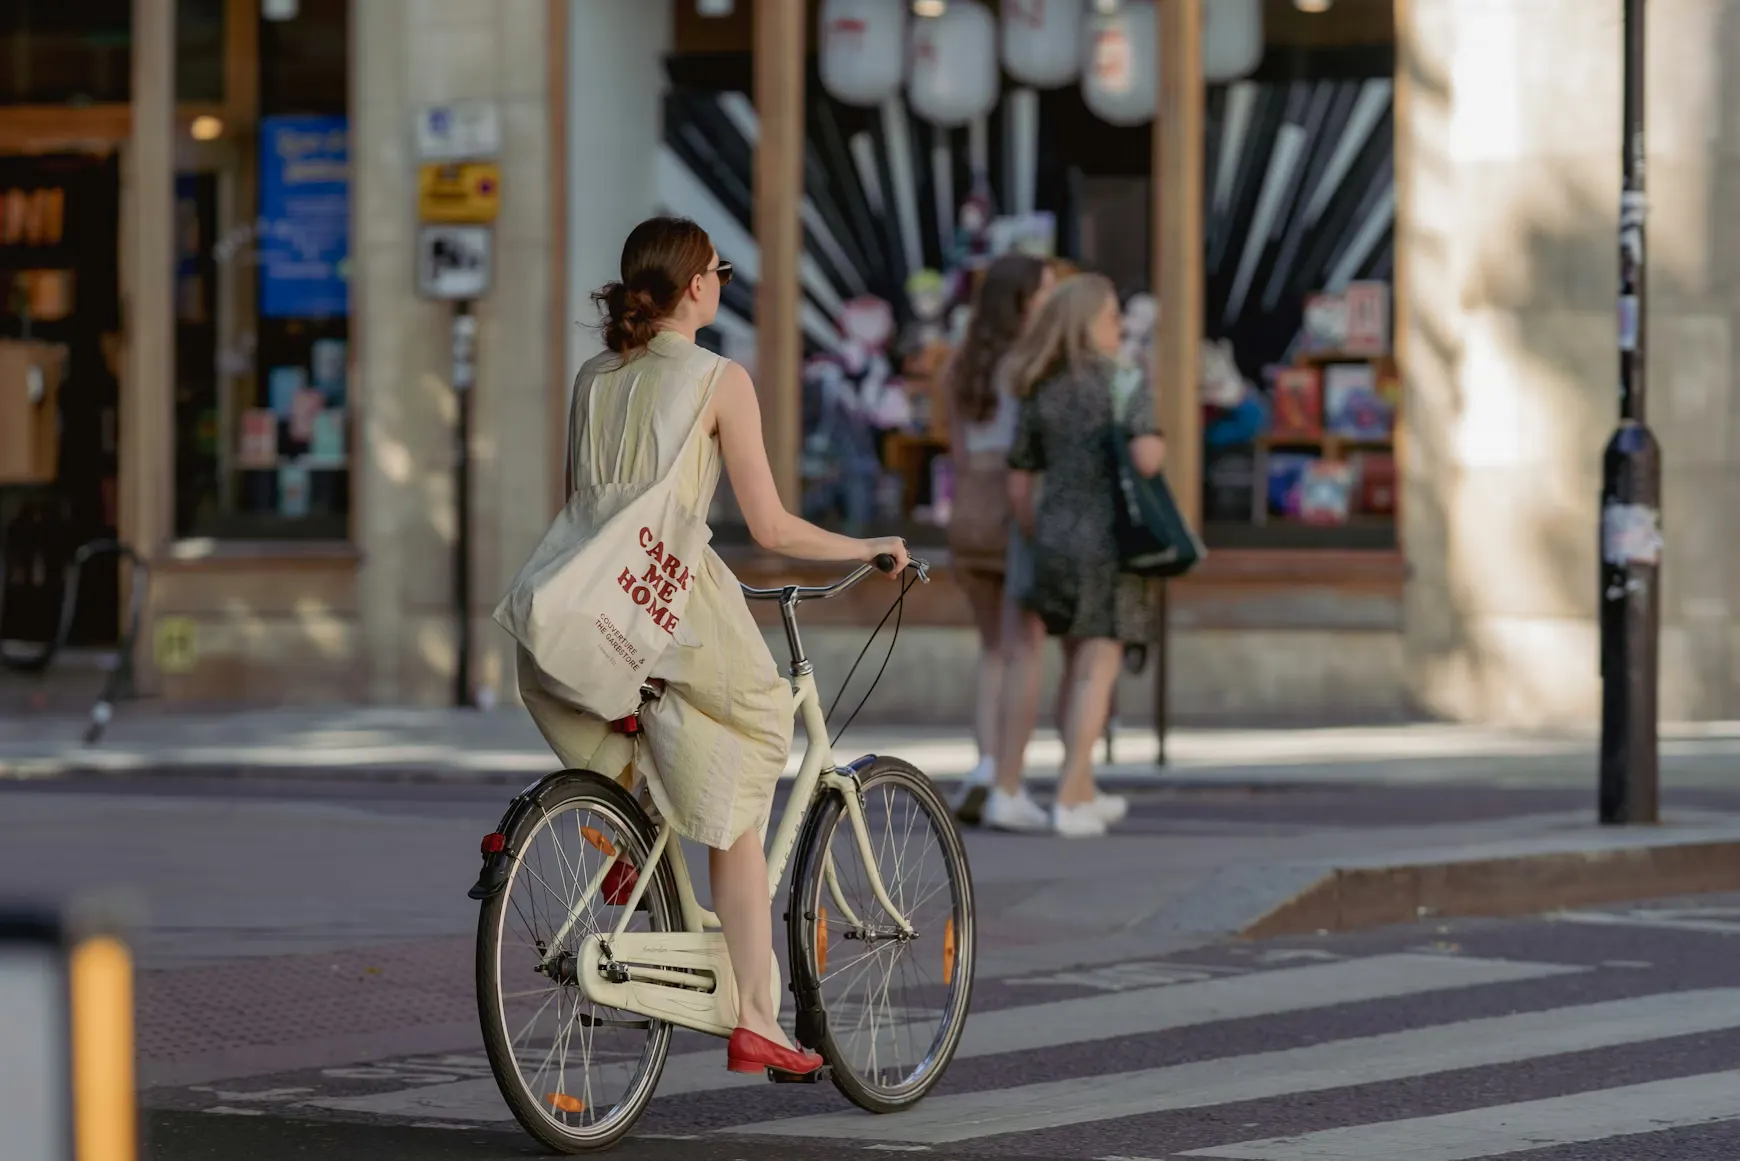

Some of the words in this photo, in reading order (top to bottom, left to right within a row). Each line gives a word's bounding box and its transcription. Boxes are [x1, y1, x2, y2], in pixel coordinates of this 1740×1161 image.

[617, 566, 680, 636] HOME
[641, 563, 678, 604] ME
[595, 619, 607, 635] THE
[605, 633, 640, 672] GARBSTORE
[600, 613, 637, 656] COUVERTURE
[638, 657, 646, 665] &
